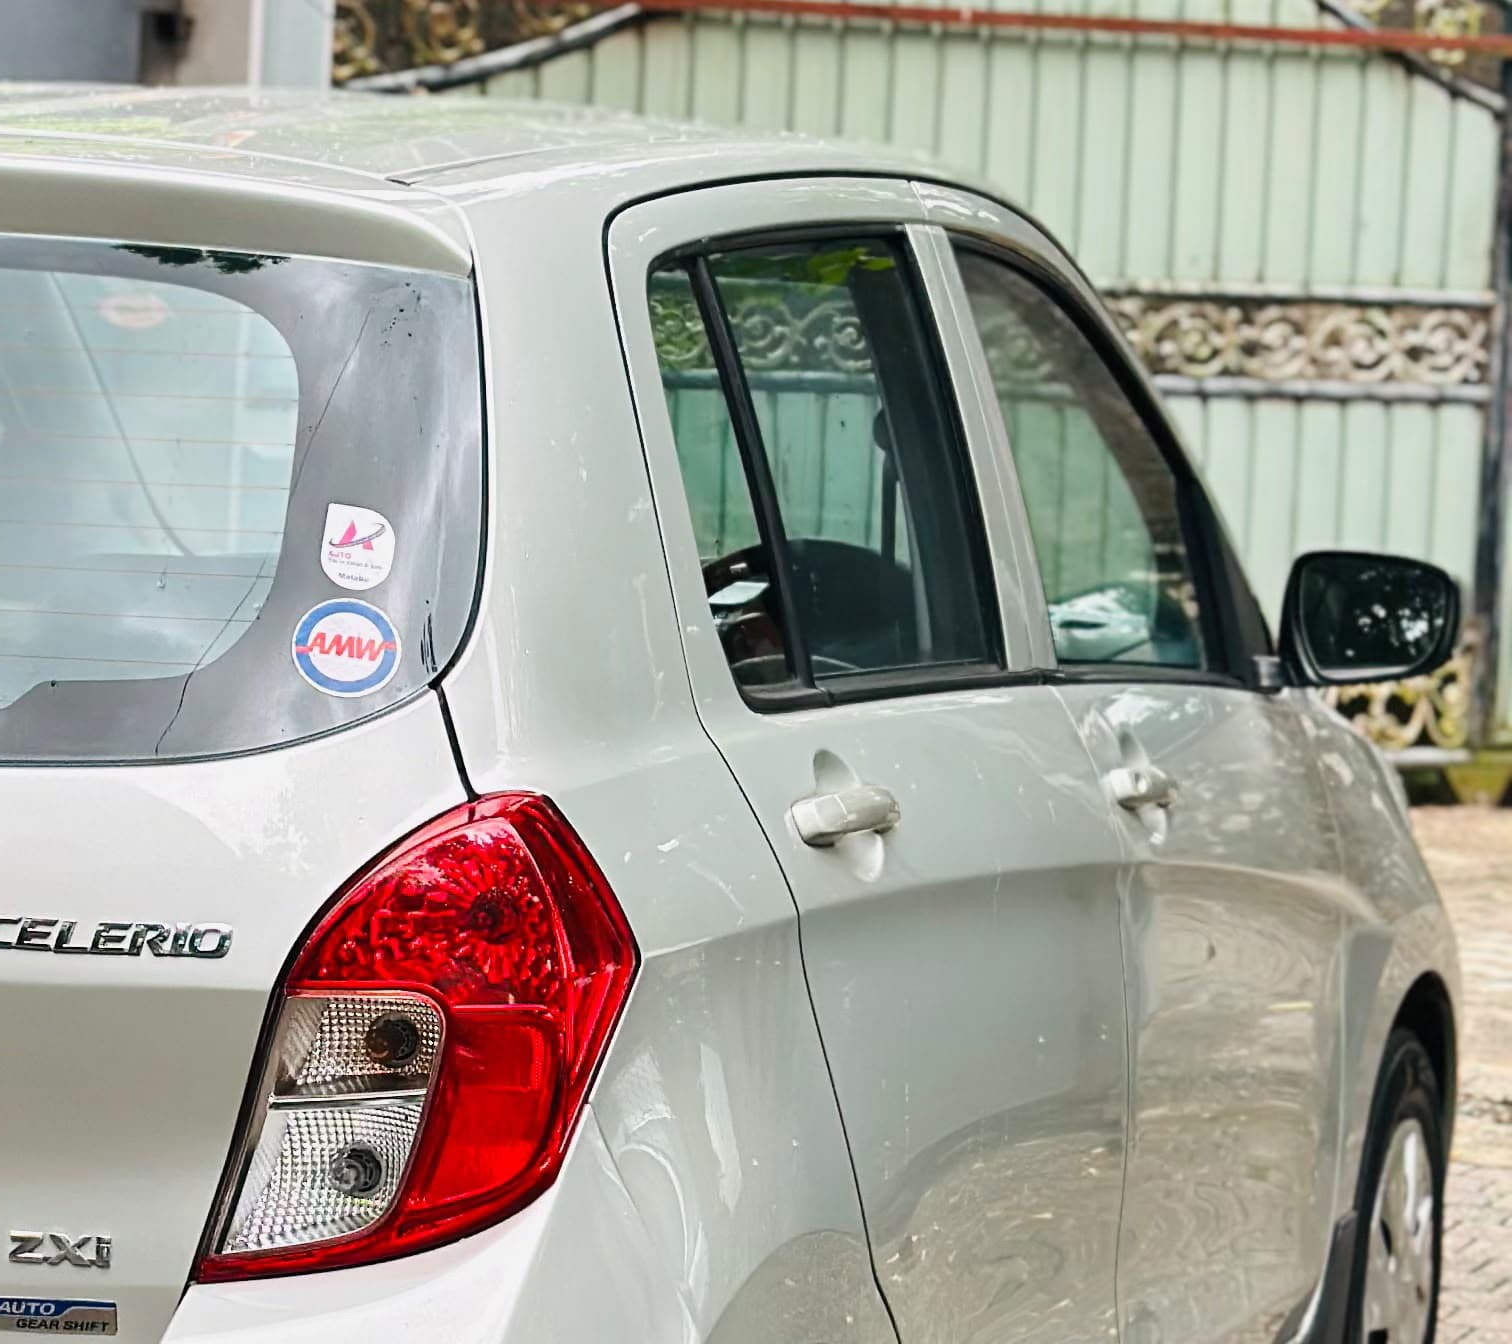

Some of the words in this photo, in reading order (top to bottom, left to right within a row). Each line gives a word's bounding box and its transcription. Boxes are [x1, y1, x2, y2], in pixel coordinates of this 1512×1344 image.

[310, 632, 385, 661] AMW
[16, 1318, 60, 1331] GEAR
[63, 1320, 110, 1332] SHIFT
